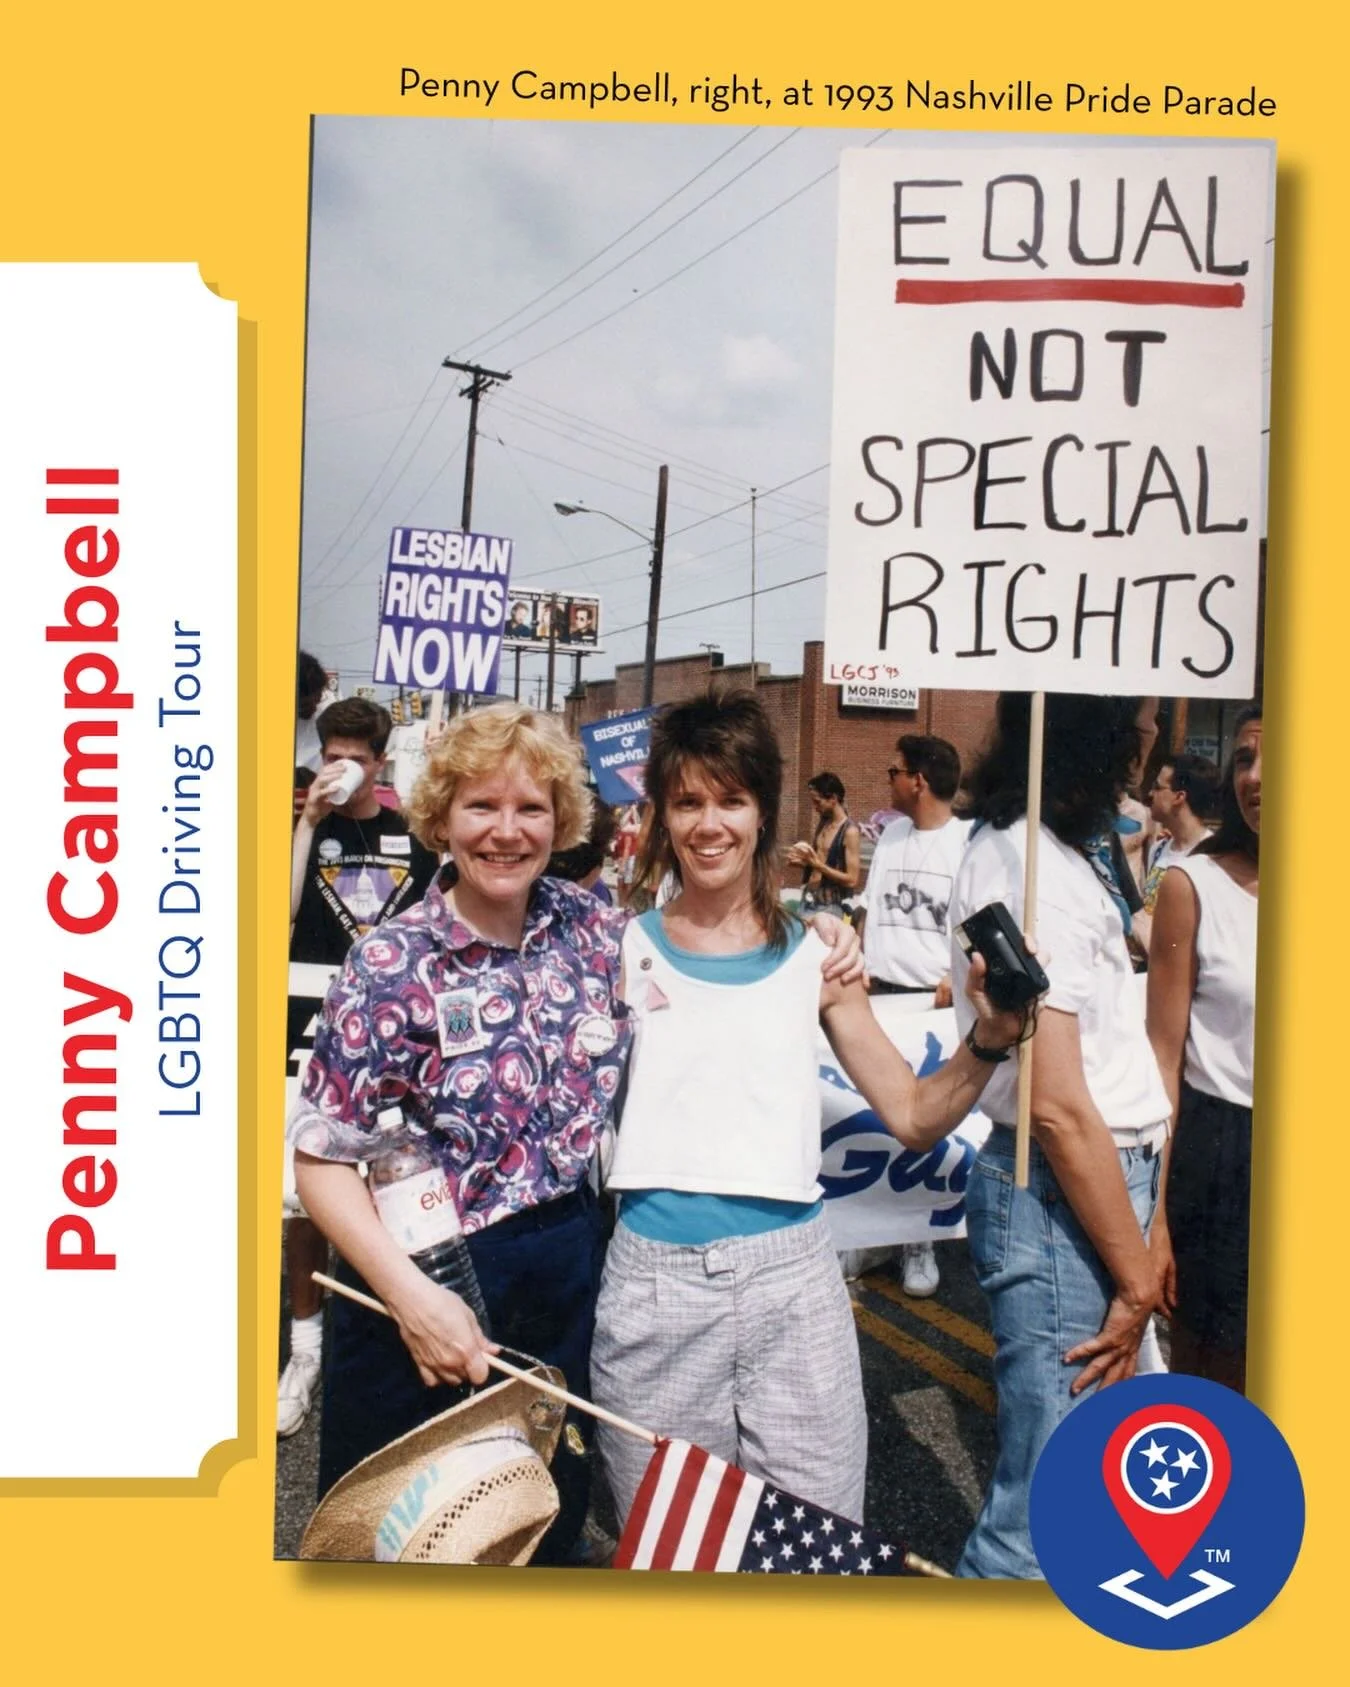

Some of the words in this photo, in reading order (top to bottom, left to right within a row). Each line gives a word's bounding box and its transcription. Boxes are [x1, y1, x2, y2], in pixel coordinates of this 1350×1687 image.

[895, 174, 1249, 275] EQUAL
[970, 327, 1167, 407] NOT
[855, 434, 1248, 537] SPECIAL
[391, 529, 511, 575] LESBIAN
[385, 571, 504, 628] RIGHTS
[878, 552, 1236, 678] RIGHTS
[374, 624, 500, 692] NOW
[847, 685, 917, 700] MORRISON
[620, 735, 637, 748] OF
